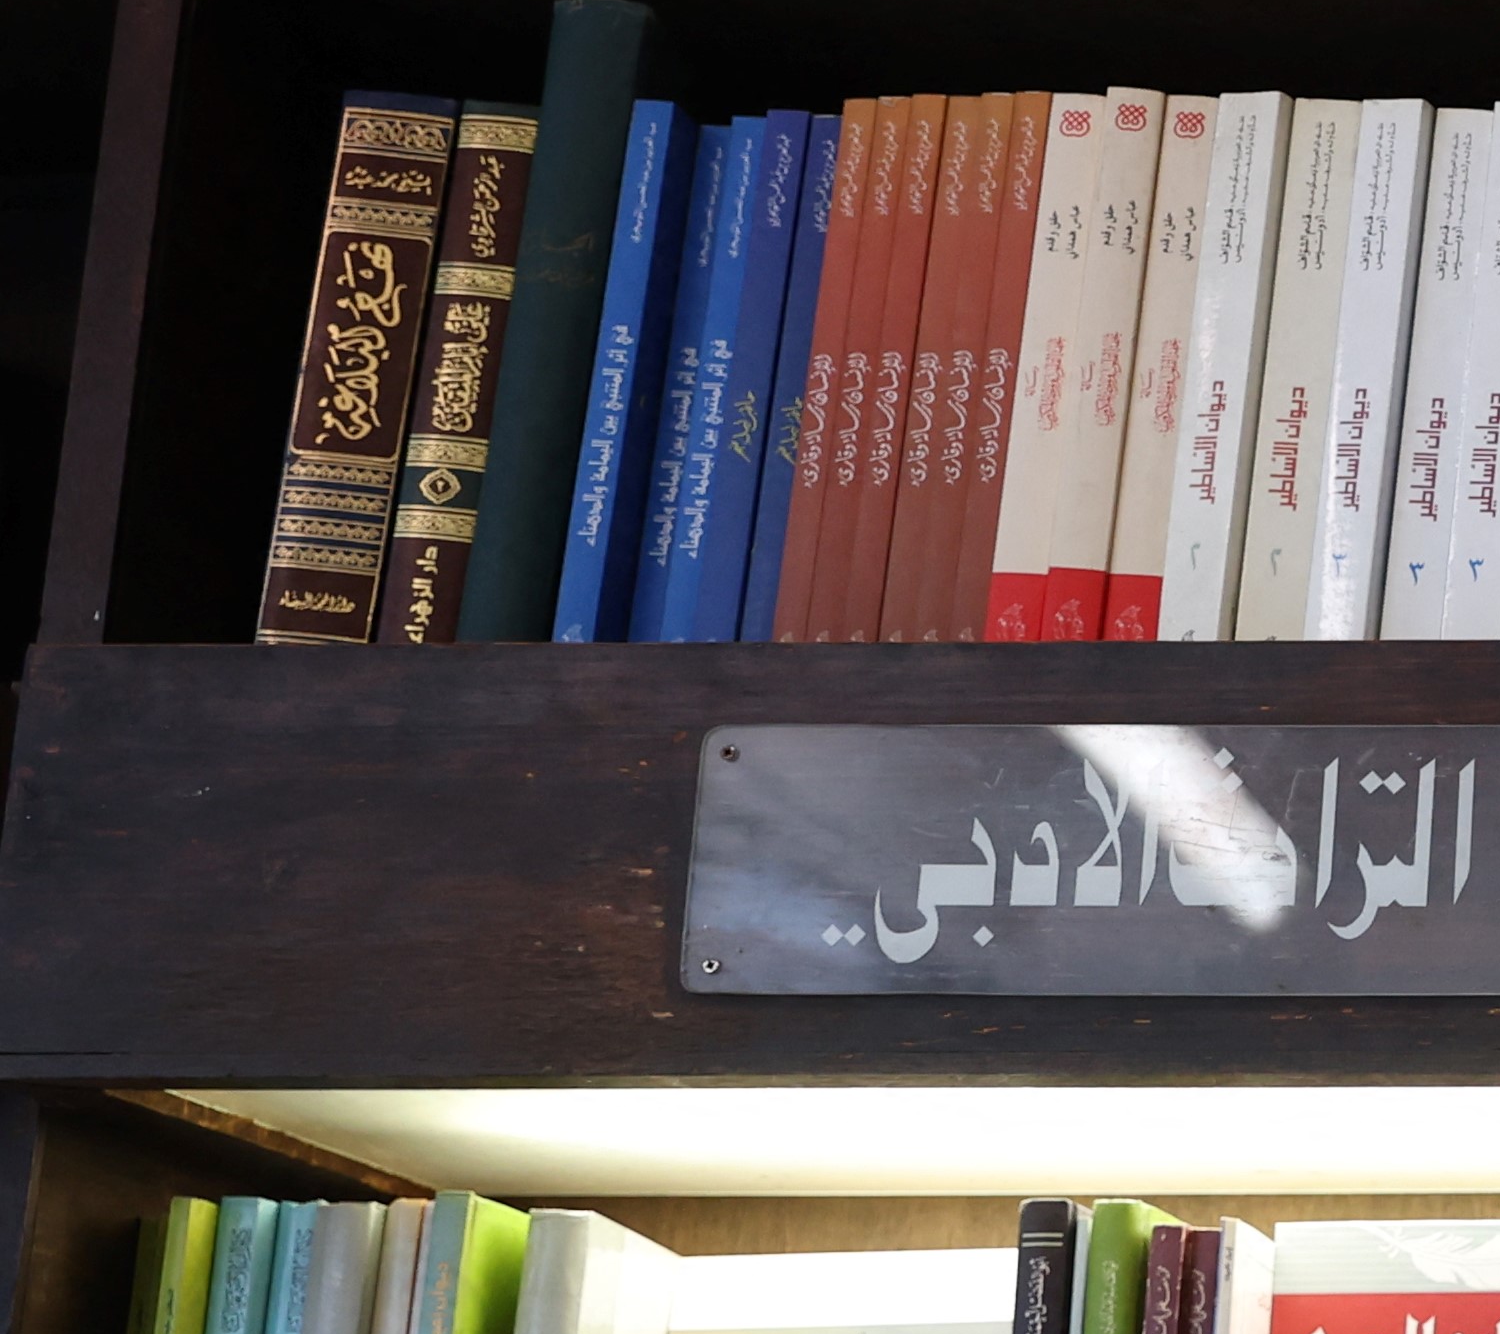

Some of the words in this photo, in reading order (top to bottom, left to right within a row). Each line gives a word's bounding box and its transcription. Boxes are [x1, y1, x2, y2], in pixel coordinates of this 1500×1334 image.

[598, 413, 619, 436] بين
[414, 545, 439, 574] دار
[403, 576, 435, 644] الزهراء
[1167, 745, 1476, 941] التراث
